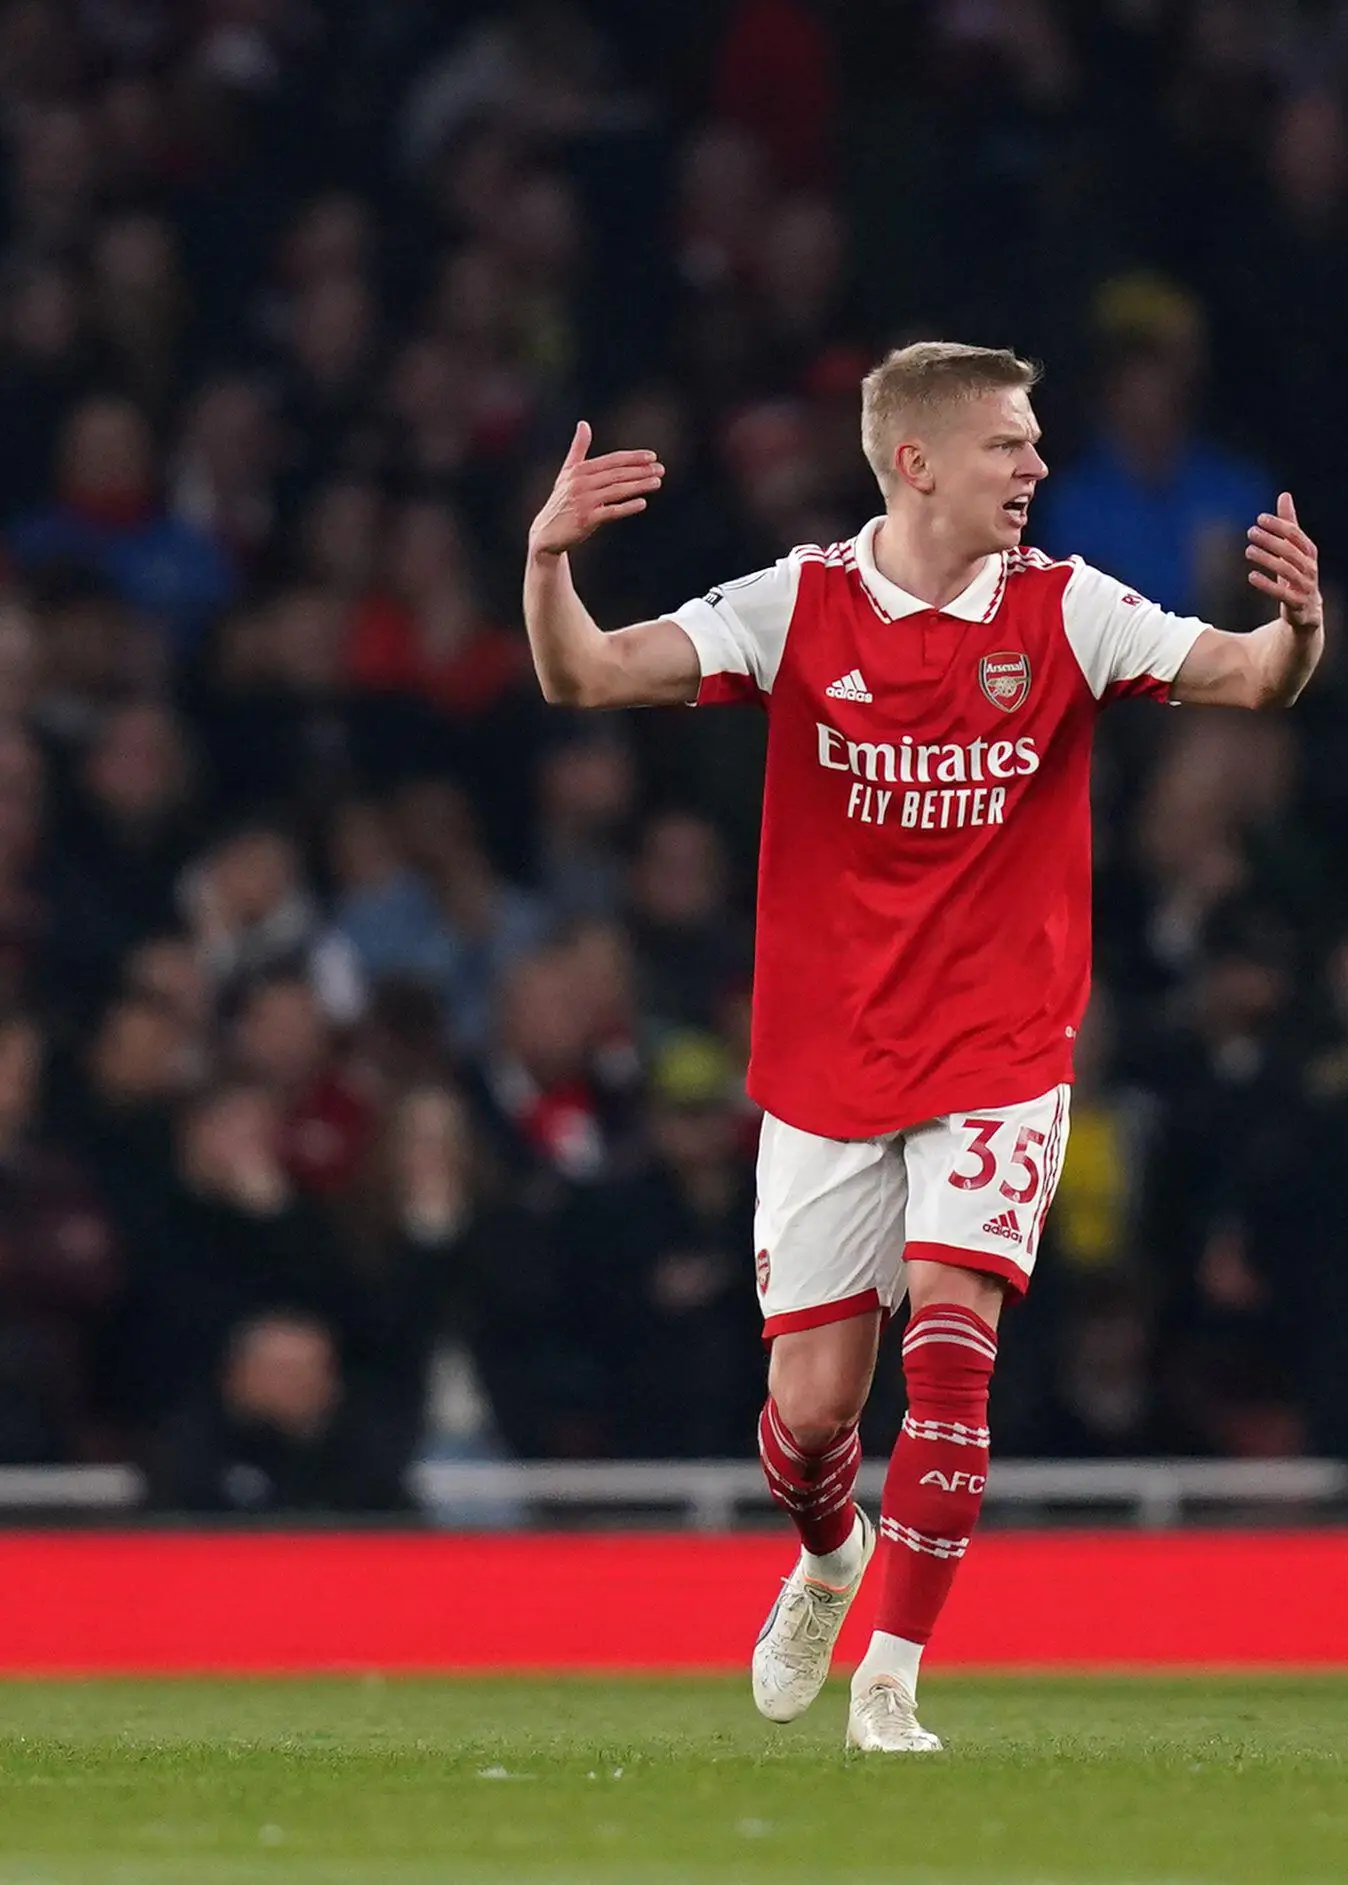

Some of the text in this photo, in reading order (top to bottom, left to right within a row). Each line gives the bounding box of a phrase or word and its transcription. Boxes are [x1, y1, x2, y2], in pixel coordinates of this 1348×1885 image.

[986, 660, 1024, 674] Arsenal
[825, 686, 873, 703] adidas
[816, 722, 1040, 783] Emirates
[847, 782, 1006, 829] FLY BETTER
[948, 1118, 1046, 1204] 35
[919, 1470, 986, 1494] AFC
